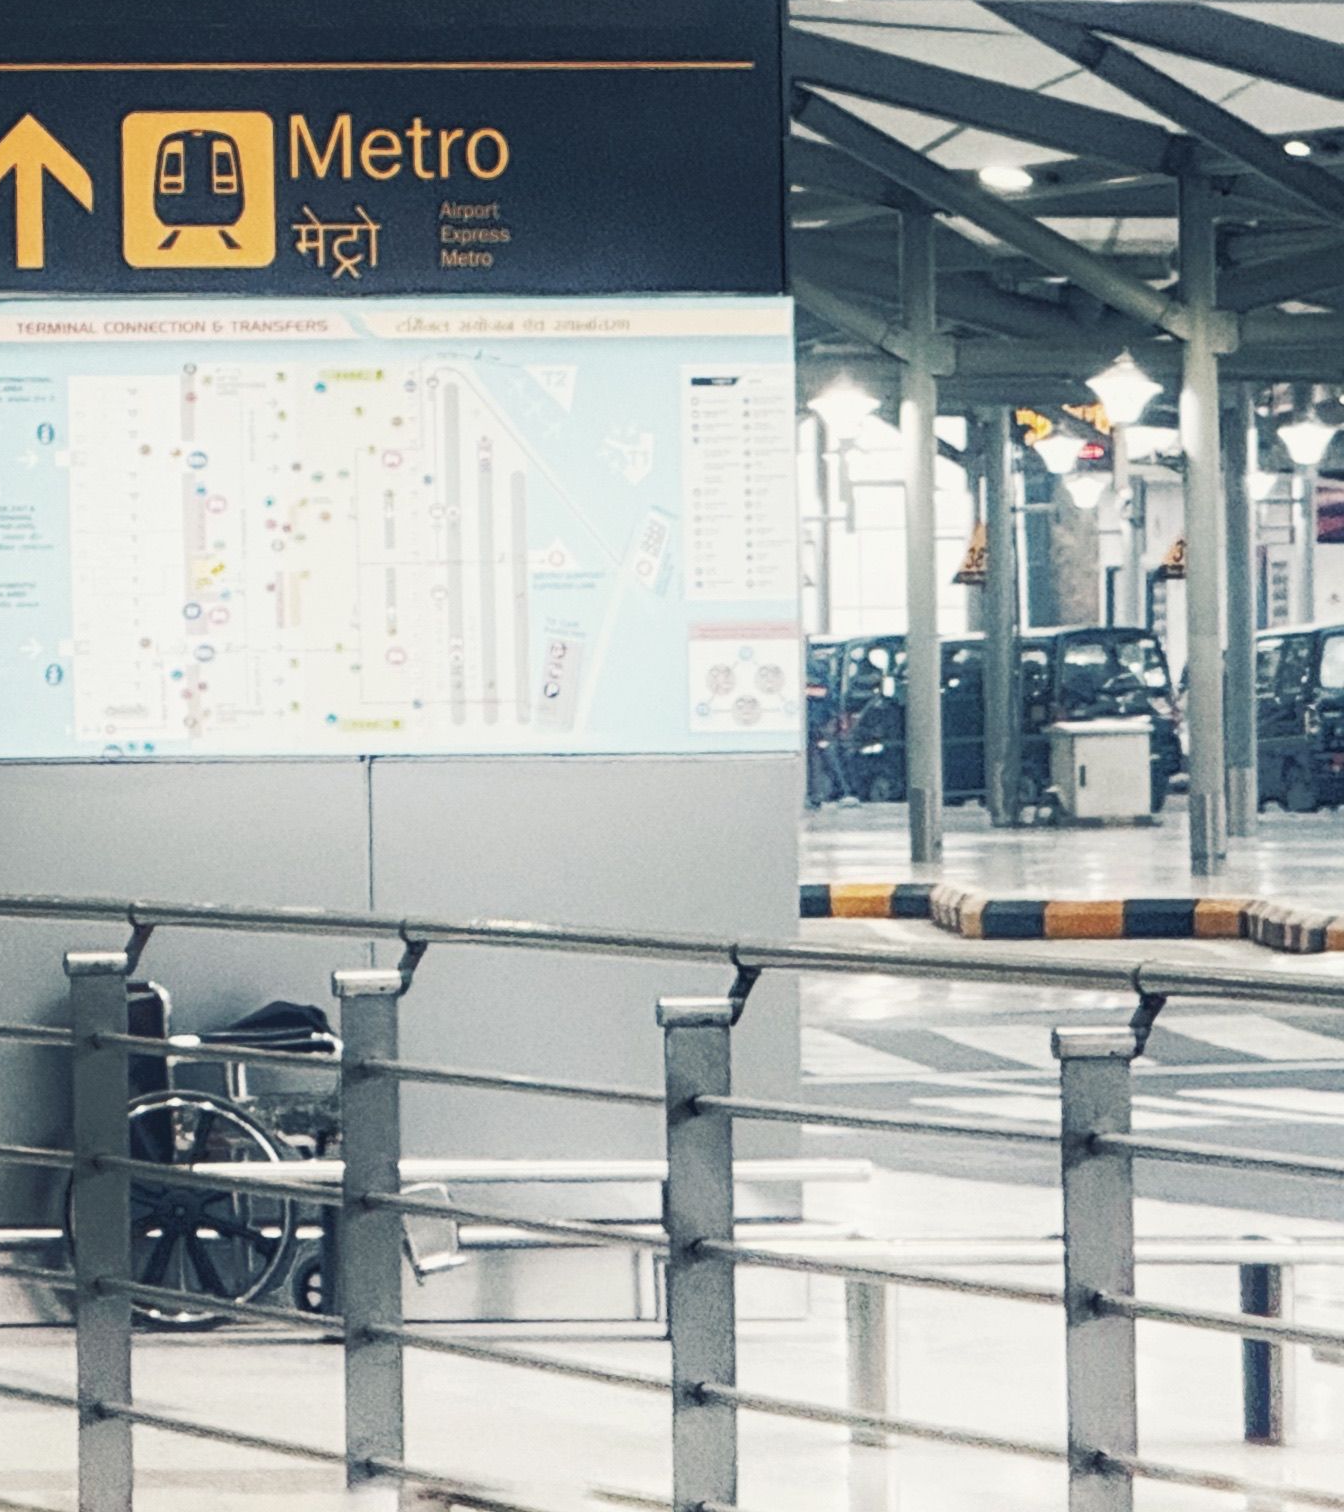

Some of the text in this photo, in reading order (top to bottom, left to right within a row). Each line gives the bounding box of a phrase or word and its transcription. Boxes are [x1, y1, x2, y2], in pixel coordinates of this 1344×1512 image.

[288, 113, 509, 181] Metro
[440, 201, 500, 220] Airport
[291, 205, 381, 279] मेट्रो
[440, 226, 510, 243] Express
[440, 249, 493, 267] Metro
[16, 321, 96, 335] TERMINAL
[103, 320, 206, 334] CONNECTION
[230, 319, 329, 333] TRANSFERS
